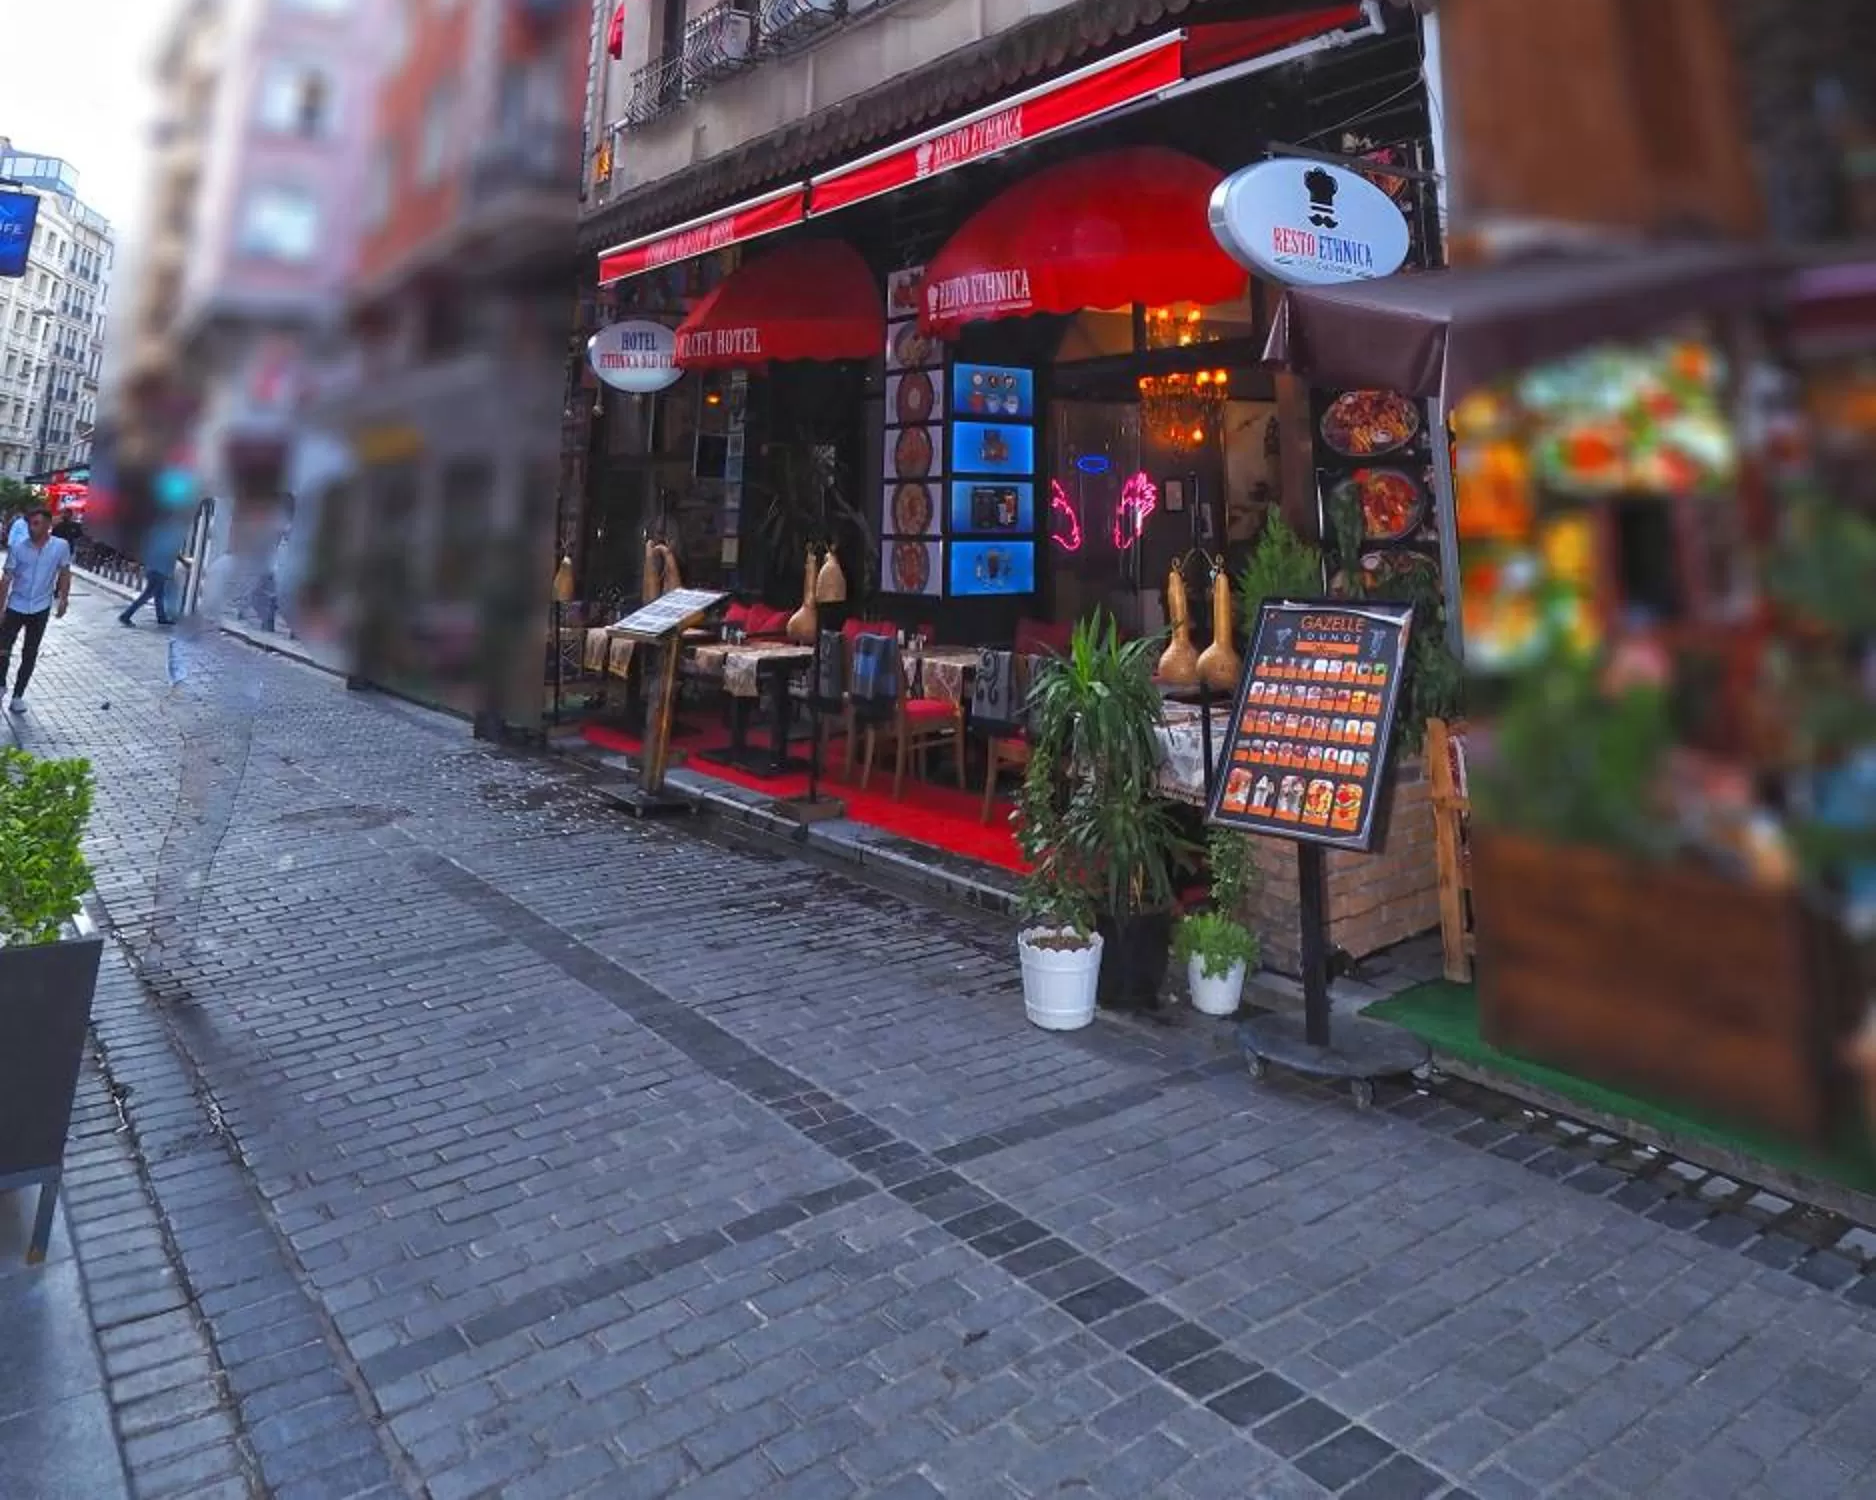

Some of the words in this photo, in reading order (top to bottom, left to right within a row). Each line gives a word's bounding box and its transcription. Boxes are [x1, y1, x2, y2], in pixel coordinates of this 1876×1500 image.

[1272, 227, 1316, 257] RESTO
[1319, 235, 1373, 269] ETHNICA
[939, 276, 969, 311] RESTO
[971, 268, 1031, 305] ETHNICA
[621, 331, 657, 351] HOTEL
[717, 327, 761, 355] HOTEL
[1301, 615, 1365, 633] GAZELLE
